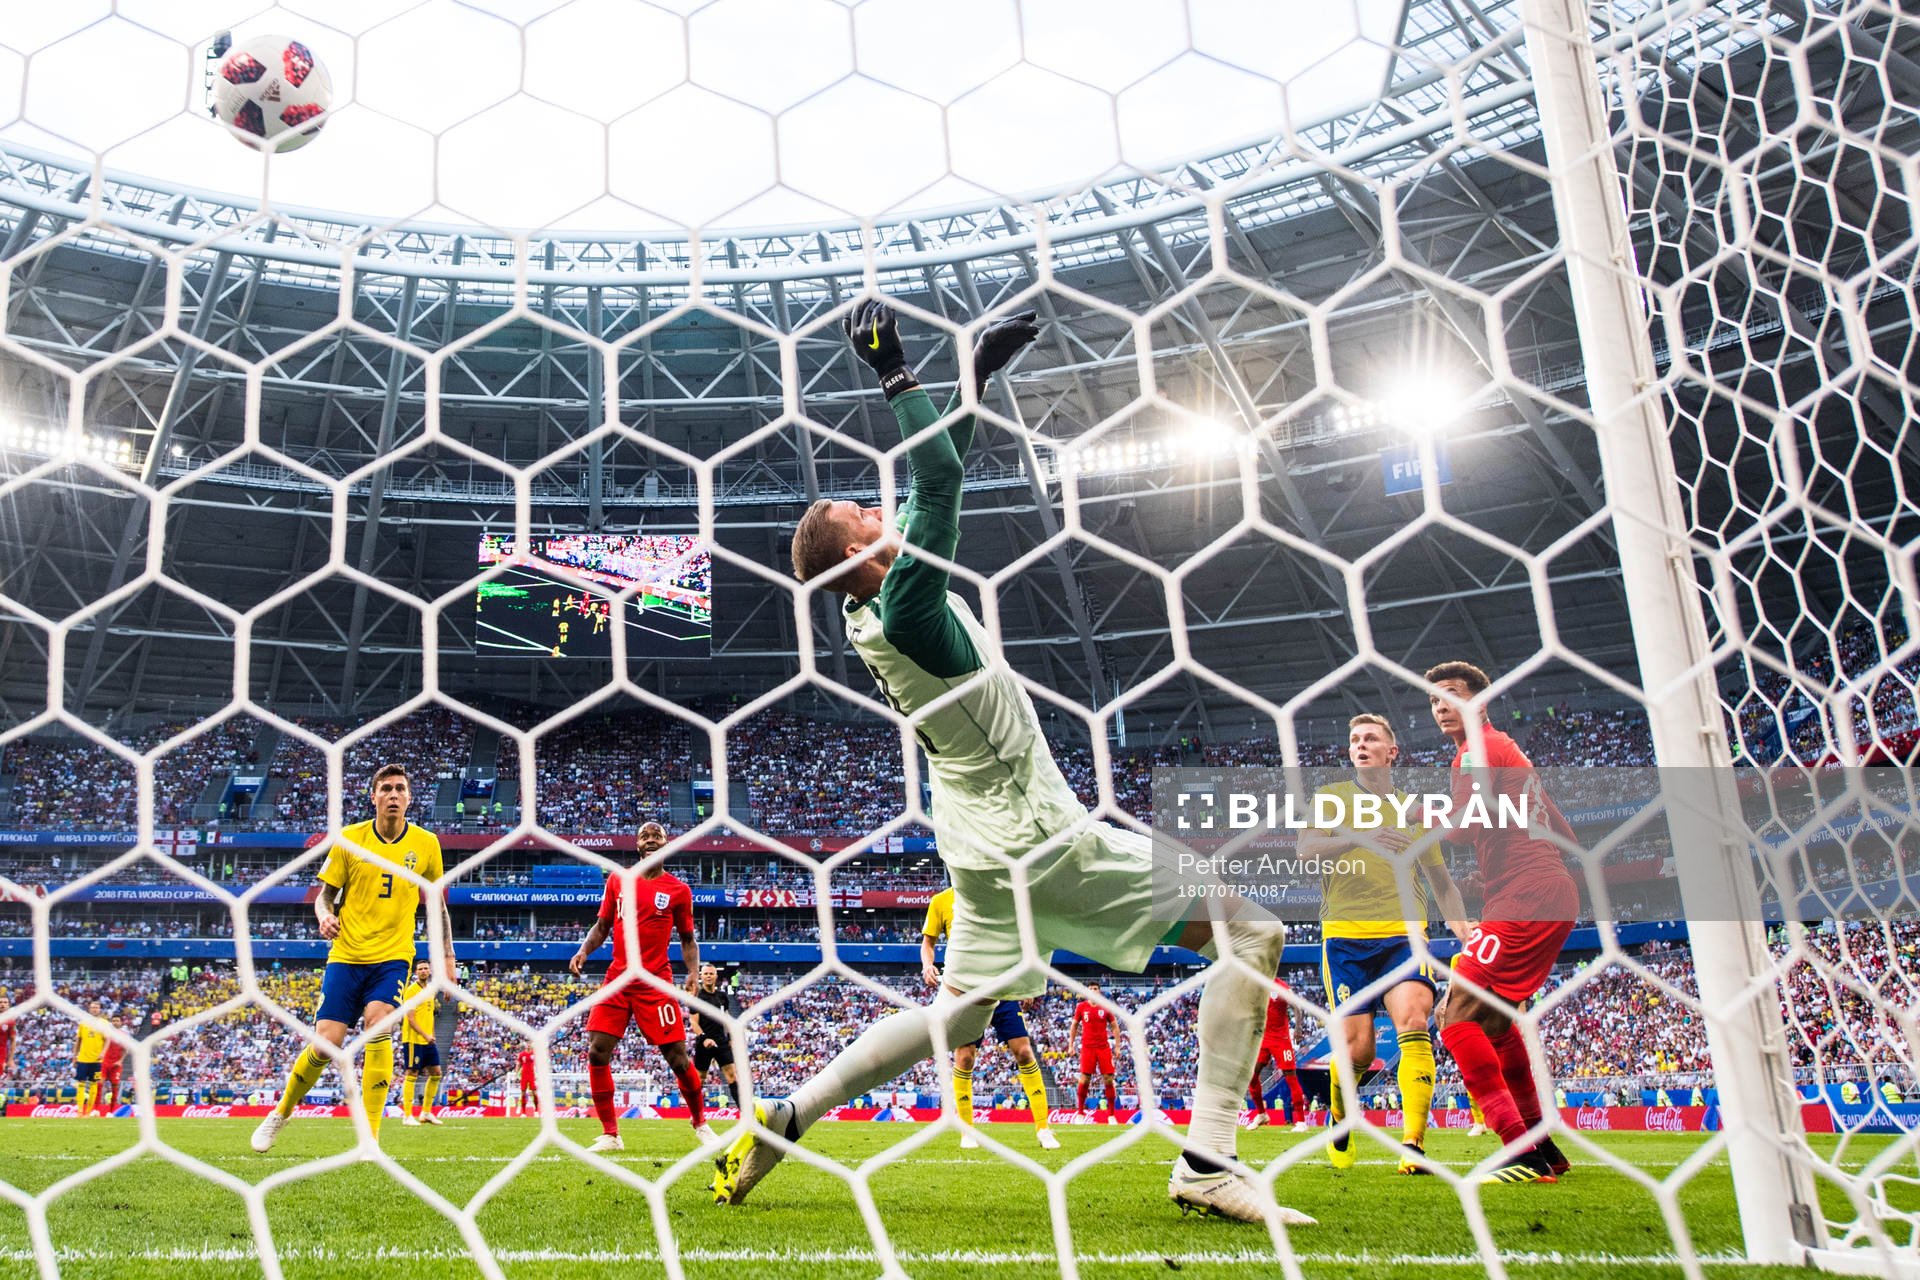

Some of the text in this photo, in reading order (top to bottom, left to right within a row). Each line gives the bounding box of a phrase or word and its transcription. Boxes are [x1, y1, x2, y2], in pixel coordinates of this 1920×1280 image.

[885, 373, 905, 388] OLSEN
[1392, 460, 1439, 479] FIF
[0, 833, 38, 842] ПИОНАТ
[572, 838, 613, 847] САМАРА
[378, 874, 393, 899] 3
[95, 890, 218, 899] 2018 FIFA WORLD CUP RUS
[470, 893, 716, 902] ЧЕМПИОНАТ МИРА ПО ФУТБ ССИИ
[1462, 928, 1501, 965] 20
[657, 1003, 677, 1028] 10
[1283, 1049, 1293, 1062] 18
